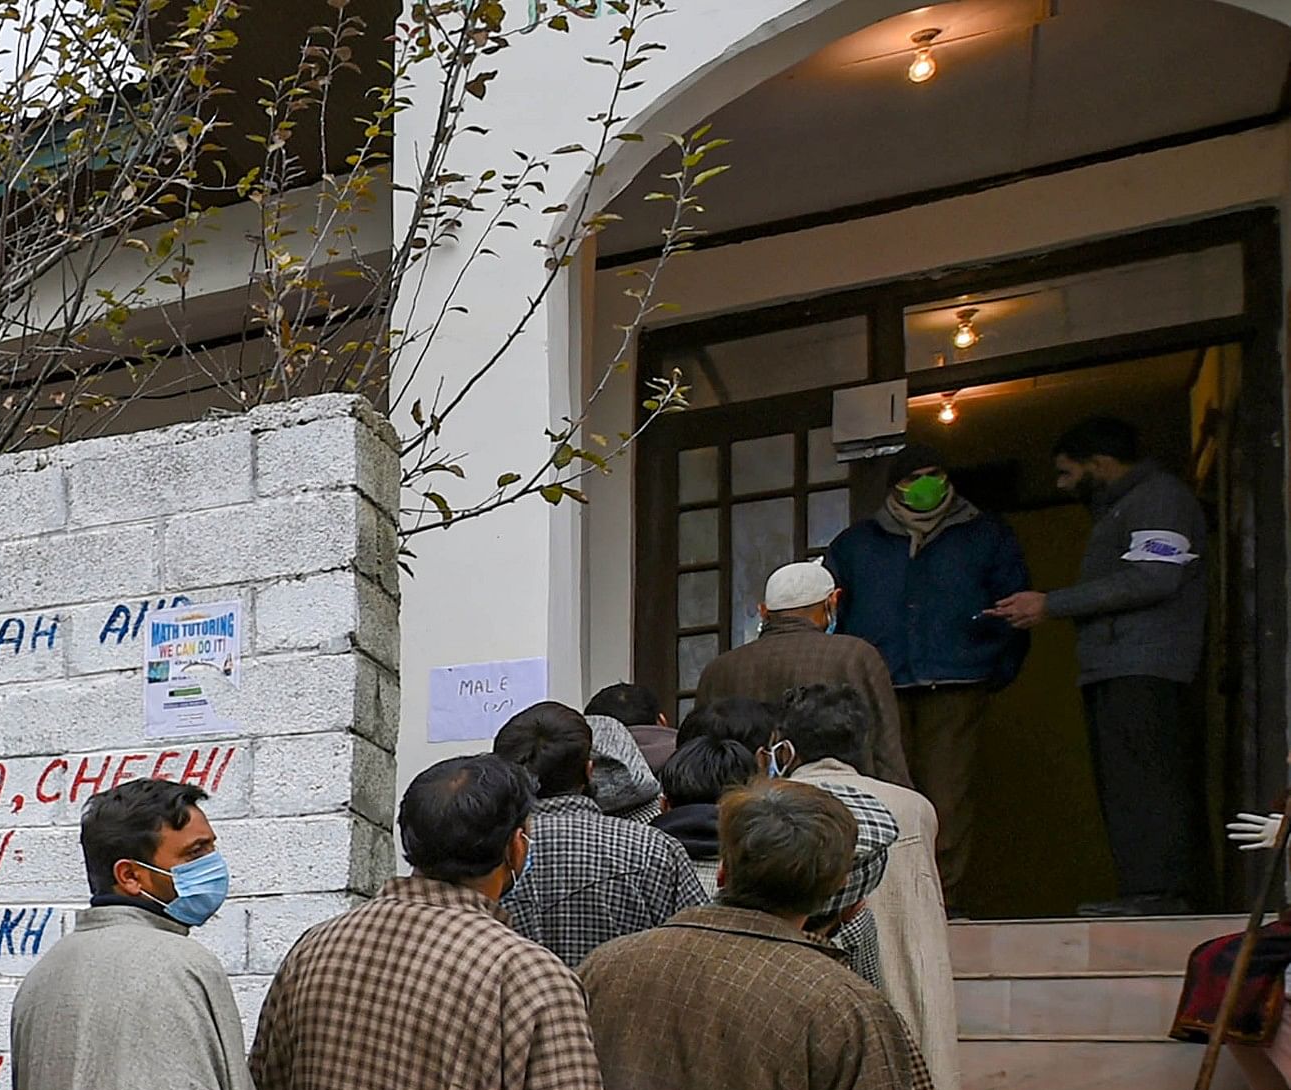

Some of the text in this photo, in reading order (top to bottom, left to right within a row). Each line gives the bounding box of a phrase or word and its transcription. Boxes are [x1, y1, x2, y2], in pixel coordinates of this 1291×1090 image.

[151, 612, 235, 648] MATH TUTORING
[159, 645, 173, 658] WE
[176, 642, 196, 656] CAN
[198, 640, 212, 654] DO
[459, 676, 508, 696] MALE
